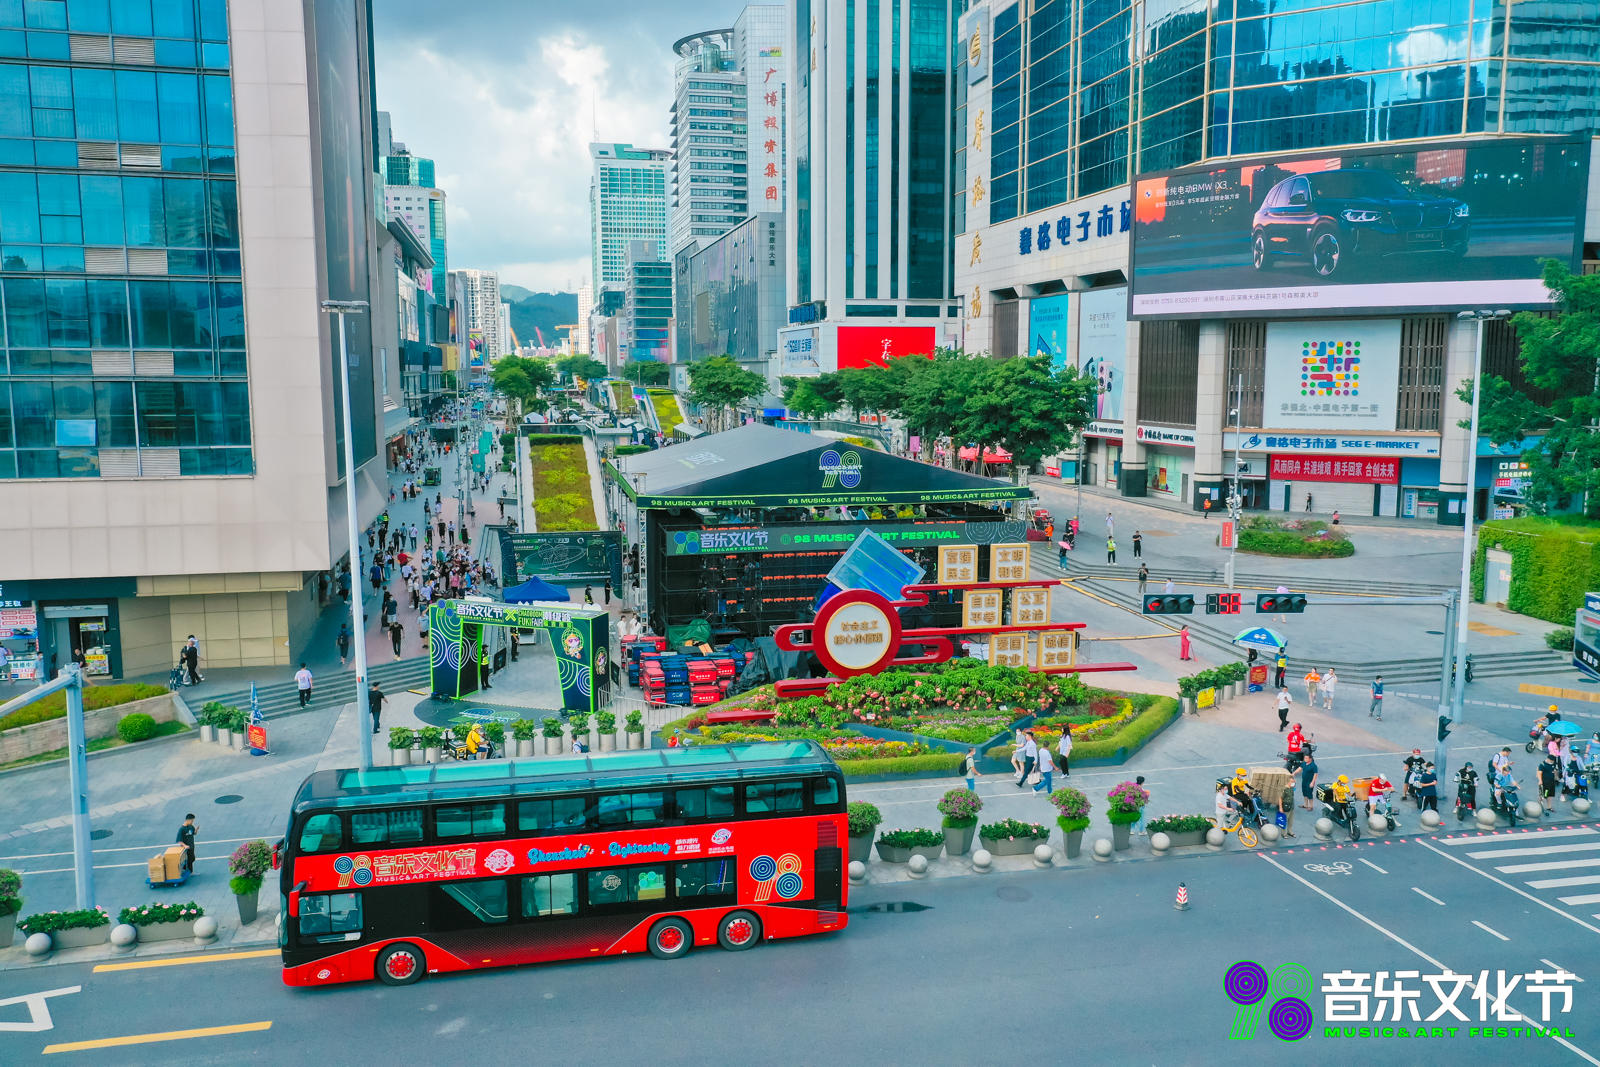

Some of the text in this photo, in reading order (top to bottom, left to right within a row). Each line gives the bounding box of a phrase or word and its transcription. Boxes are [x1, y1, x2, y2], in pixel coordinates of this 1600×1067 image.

[1265, 436, 1420, 449] 赛格电子市场 SEG E-MARKET
[1273, 459, 1301, 475] 风雨同舟
[1333, 461, 1363, 477] 携手回家
[1365, 462, 1395, 478] 合创未来
[850, 495, 888, 503] FESTIVAL
[981, 490, 1017, 499] FESTIVAL
[700, 530, 769, 549] 音乐文化节
[793, 535, 811, 543] 98
[901, 530, 961, 541] FESTIVAL
[998, 549, 1024, 563] 文明
[971, 594, 997, 608] 自由
[1020, 592, 1045, 605] 公正
[1218, 592, 1242, 615] 58
[456, 603, 503, 619] 音乐文化节
[840, 619, 880, 632] 社会主义
[608, 841, 671, 859] Sightseeing
[373, 848, 477, 878] 音乐文化节
[375, 869, 477, 883] MUSIC&ART FESTIVAL
